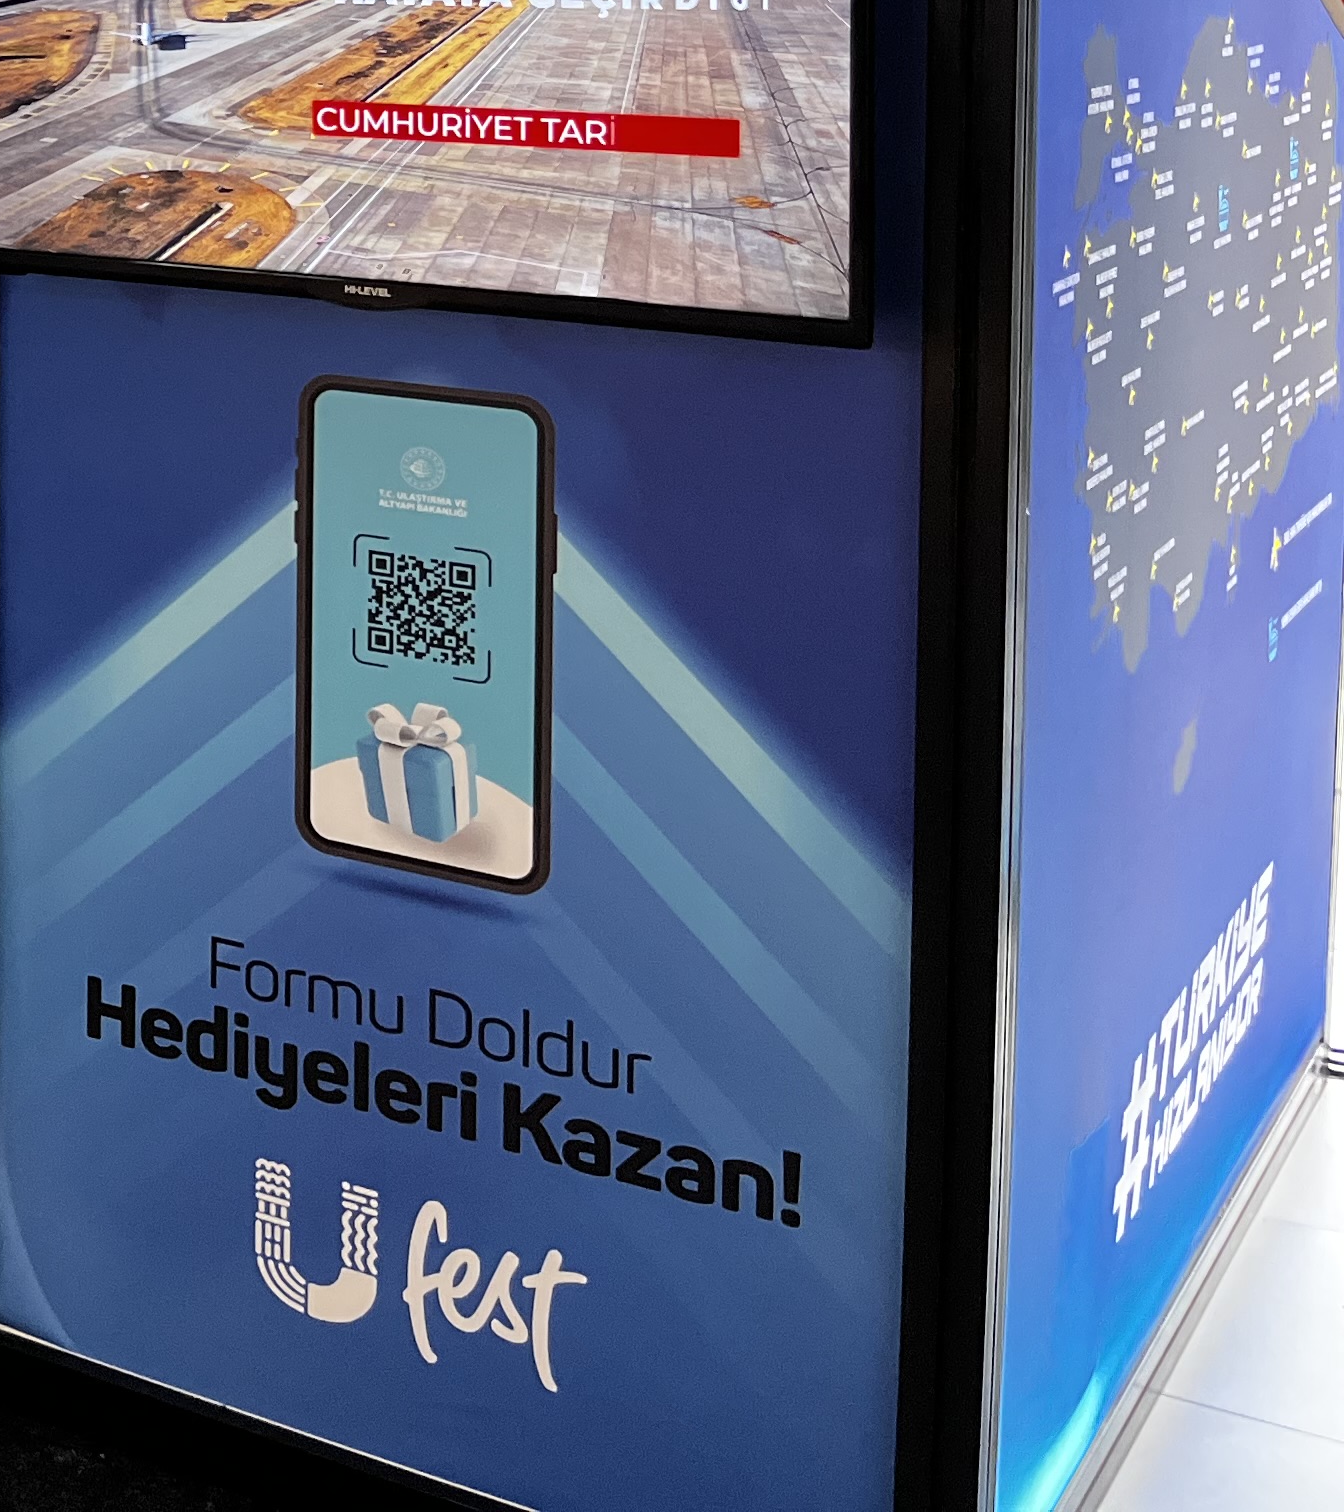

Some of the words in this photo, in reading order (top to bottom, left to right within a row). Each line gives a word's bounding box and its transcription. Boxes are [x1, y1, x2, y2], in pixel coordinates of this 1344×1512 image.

[316, 106, 532, 142] CUMHURİYET
[344, 284, 392, 298] HI-LEVEL
[454, 499, 468, 508] VE
[211, 935, 404, 1035] Formu
[428, 988, 653, 1095] Doldur
[86, 975, 479, 1142] Hediyeleri
[502, 1082, 802, 1229] Kazan!
